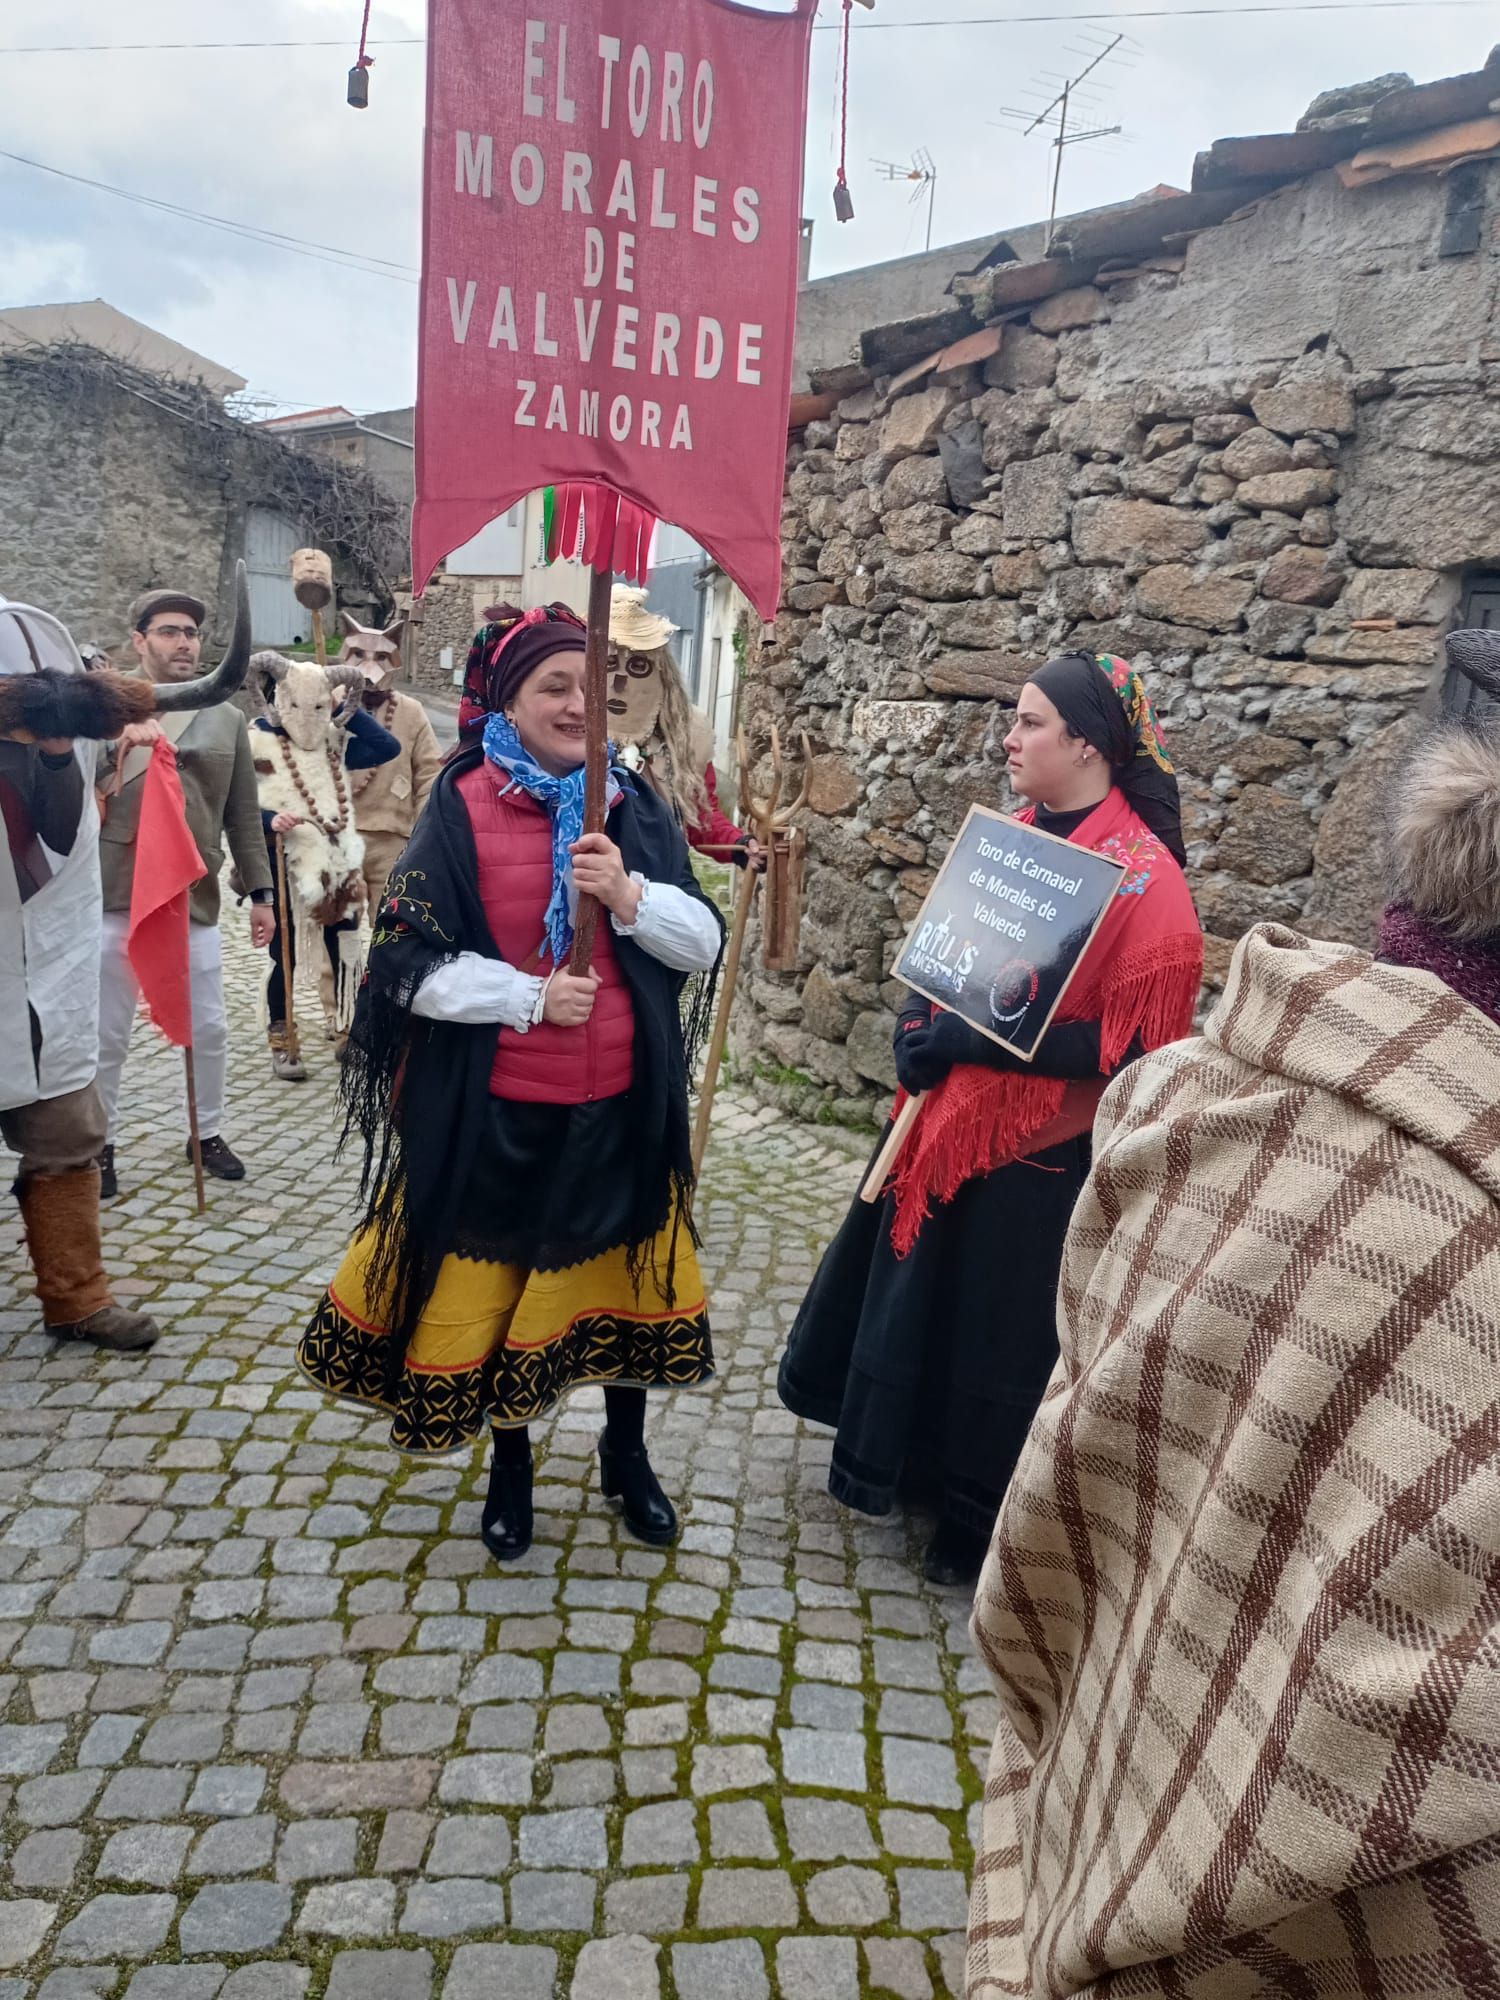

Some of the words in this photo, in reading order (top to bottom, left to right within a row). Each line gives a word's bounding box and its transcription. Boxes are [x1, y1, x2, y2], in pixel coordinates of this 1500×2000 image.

[522, 19, 576, 123] EL
[598, 34, 714, 149] TORO
[455, 130, 760, 244] MORALES
[584, 227, 636, 293] DE
[446, 277, 763, 386] VALVERDE
[514, 379, 693, 450] ZAMORA
[969, 868, 986, 887] de
[985, 875, 1038, 912] Morales
[1037, 900, 1057, 922] de
[976, 837, 1003, 863] Toro
[1003, 850, 1022, 871] de
[1021, 857, 1083, 897] Carnaval
[973, 902, 1027, 942] Valverde
